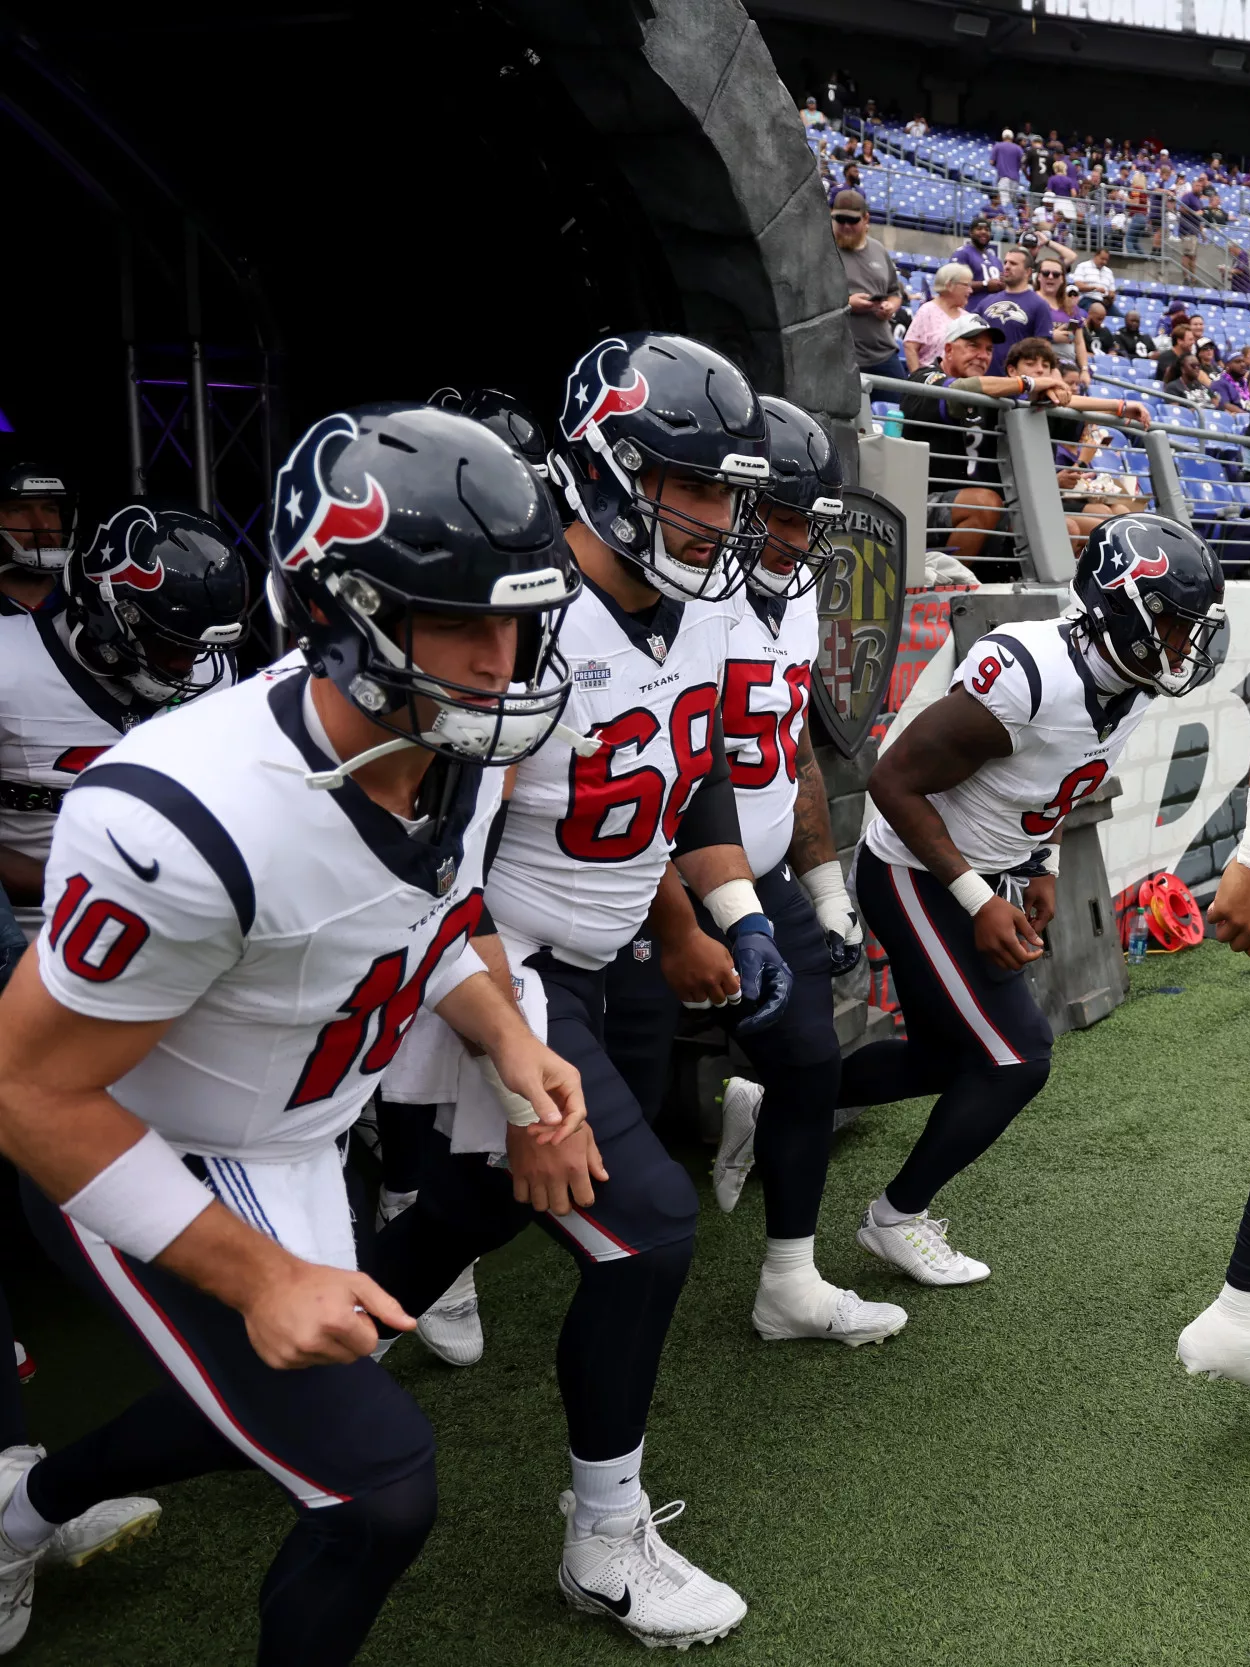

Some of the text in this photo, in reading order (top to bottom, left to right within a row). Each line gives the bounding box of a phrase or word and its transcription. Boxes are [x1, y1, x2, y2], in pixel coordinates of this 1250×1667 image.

[734, 460, 766, 469] TEXANS
[828, 510, 897, 547] VENS
[510, 576, 558, 592] TEXANS
[584, 680, 603, 688] 2023
[639, 673, 681, 694] TEXANS
[971, 655, 1002, 695] 9
[720, 658, 811, 790] 50
[555, 681, 719, 864] 68
[48, 872, 151, 984] 10
[408, 886, 460, 932] TEXANS
